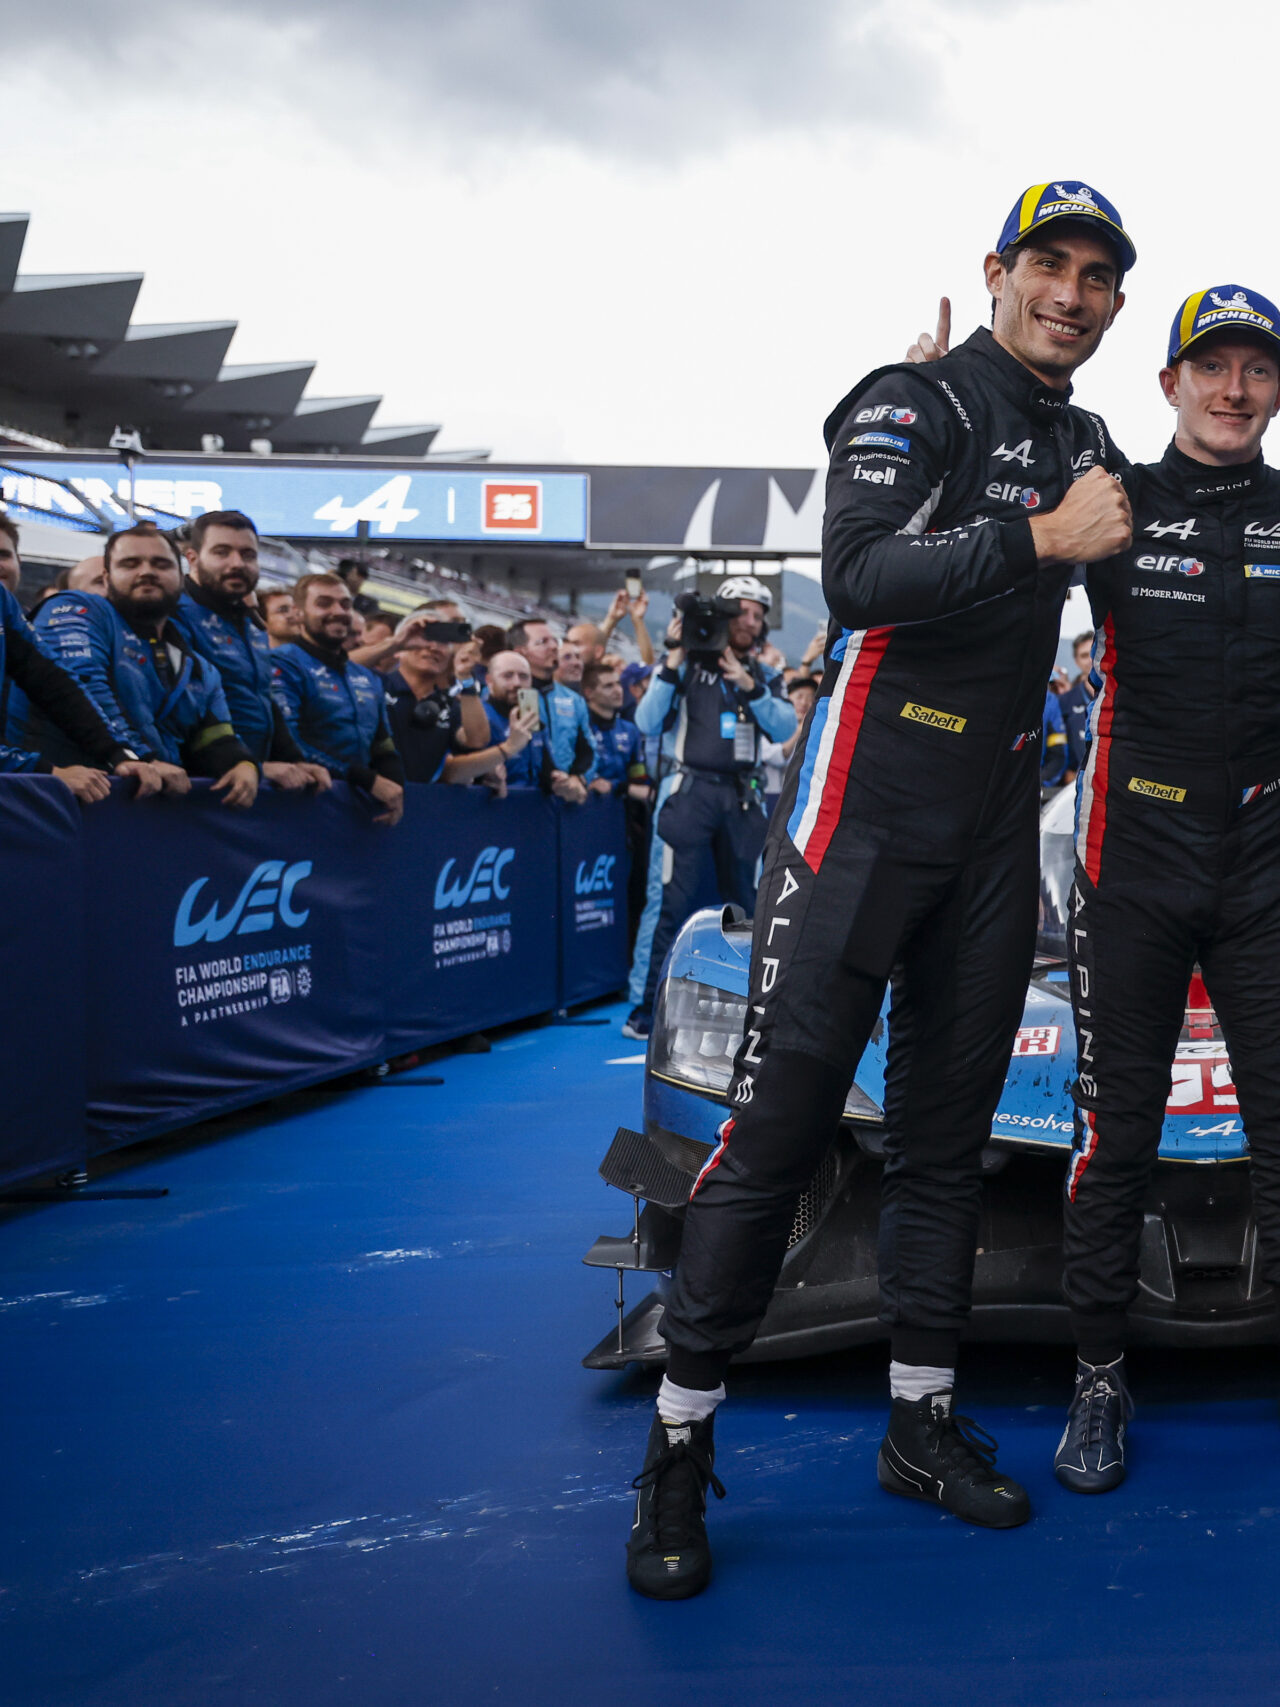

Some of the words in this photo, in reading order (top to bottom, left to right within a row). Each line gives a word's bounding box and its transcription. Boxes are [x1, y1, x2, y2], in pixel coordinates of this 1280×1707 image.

[1196, 310, 1274, 330] MICHELIN
[855, 405, 893, 424] elf
[863, 435, 905, 448] MICHELIN
[859, 452, 911, 465] businessolver
[852, 464, 897, 486] ixell
[985, 482, 1022, 503] elf
[1136, 555, 1180, 572] elf
[1140, 587, 1206, 603] MOSER.WATCH
[908, 705, 960, 731] Sabelt
[1133, 779, 1181, 801] Sabelt
[433, 846, 515, 911] WEC
[575, 854, 616, 895] WEC
[173, 859, 313, 948] WEC
[446, 918, 473, 936] WORLD
[175, 965, 198, 986] FIA
[198, 956, 243, 981] WORLD
[243, 944, 313, 972] ENDURANCE
[177, 971, 269, 1008] CHAMPIONSHIP
[734, 866, 800, 1104] ALPINE
[1074, 882, 1098, 1098] ALPINE
[181, 1015, 189, 1027] A
[194, 995, 269, 1024] PARTNERSHIP
